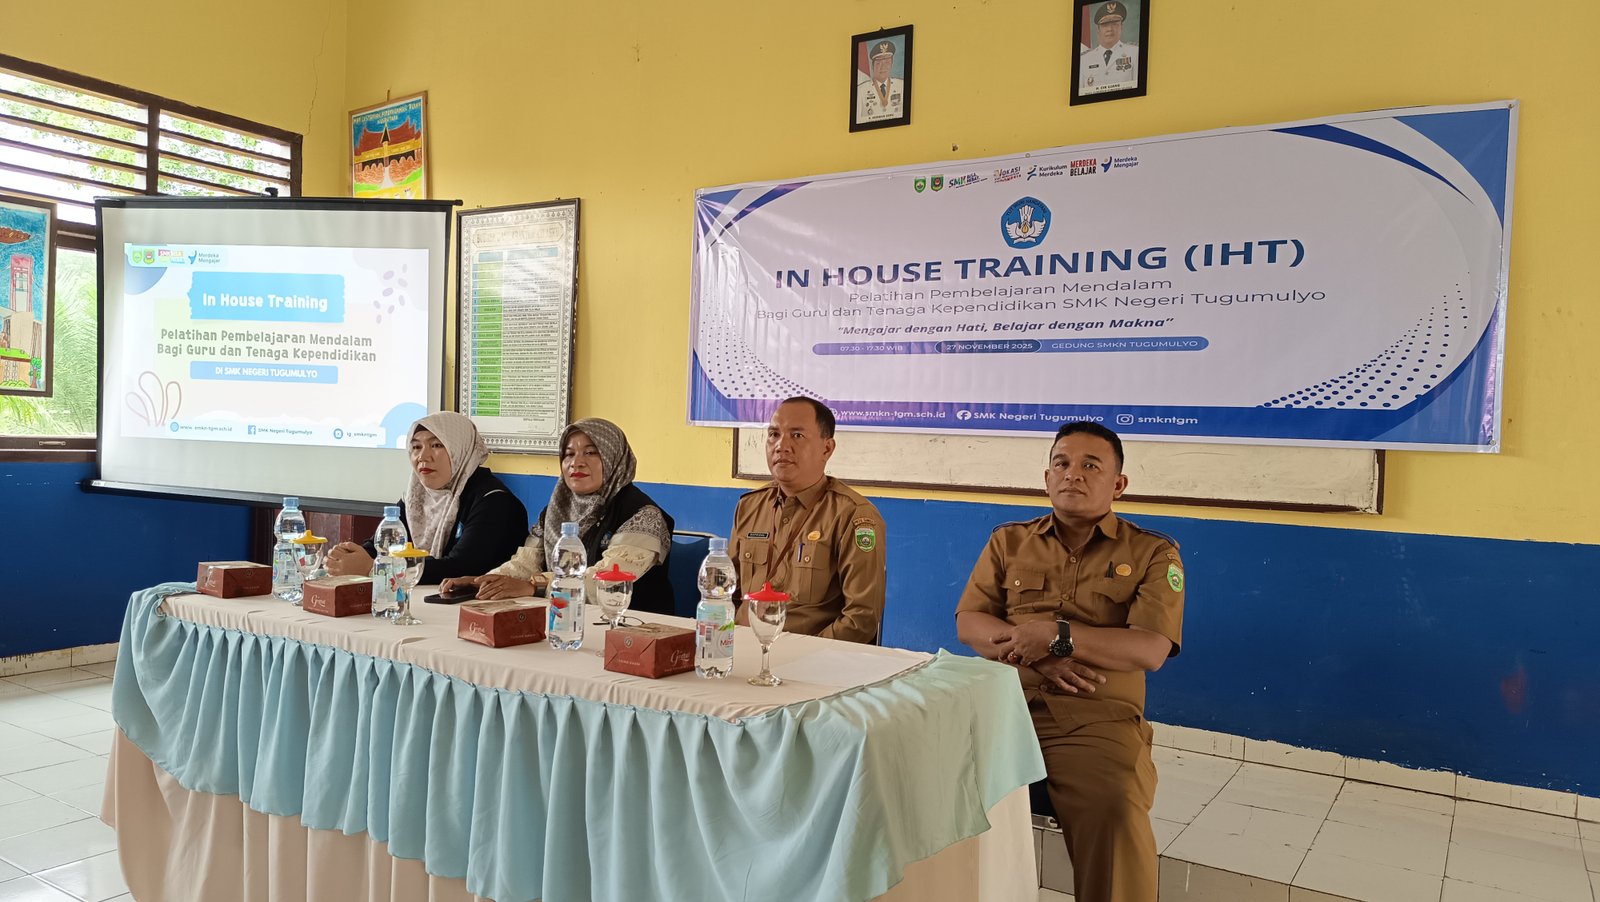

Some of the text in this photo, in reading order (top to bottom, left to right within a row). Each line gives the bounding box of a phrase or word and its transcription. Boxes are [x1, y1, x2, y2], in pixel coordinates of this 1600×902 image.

[1039, 164, 1068, 172] Kurikulum
[1070, 158, 1097, 168] MERDEKA
[1114, 160, 1139, 169] Mengajar
[1039, 170, 1063, 178] Merdeka
[1070, 166, 1097, 177] BELAJAR
[949, 176, 966, 188] SMK
[776, 239, 1305, 288] IN HOUSE TRAINING (IHT)
[850, 280, 1172, 303] Pelatihan Pembelajaran Mendalam
[203, 293, 328, 312] In House Training
[758, 290, 1326, 320] Bagi Guru dan Tenaga Kependidikan SMK Negeri Tugumulyo
[904, 324, 952, 335] dengan
[956, 322, 988, 333] Hati,
[992, 321, 1044, 332] Belajar
[1048, 320, 1104, 331] dengan
[161, 328, 372, 347] Pelatihan Pembelajaran Mendalam
[1129, 340, 1198, 348] TUGUMULYO
[157, 343, 376, 363] Bagi Guru dan Tenaga Kependidikan
[215, 367, 318, 378] DI SMK NEGERI TUGUMULYO
[840, 410, 946, 418] www.smkn-tgm.sch.id
[1000, 412, 1036, 421] Negeri
[1040, 414, 1104, 422] Tugumulyo
[1138, 415, 1198, 425] smkntgm
